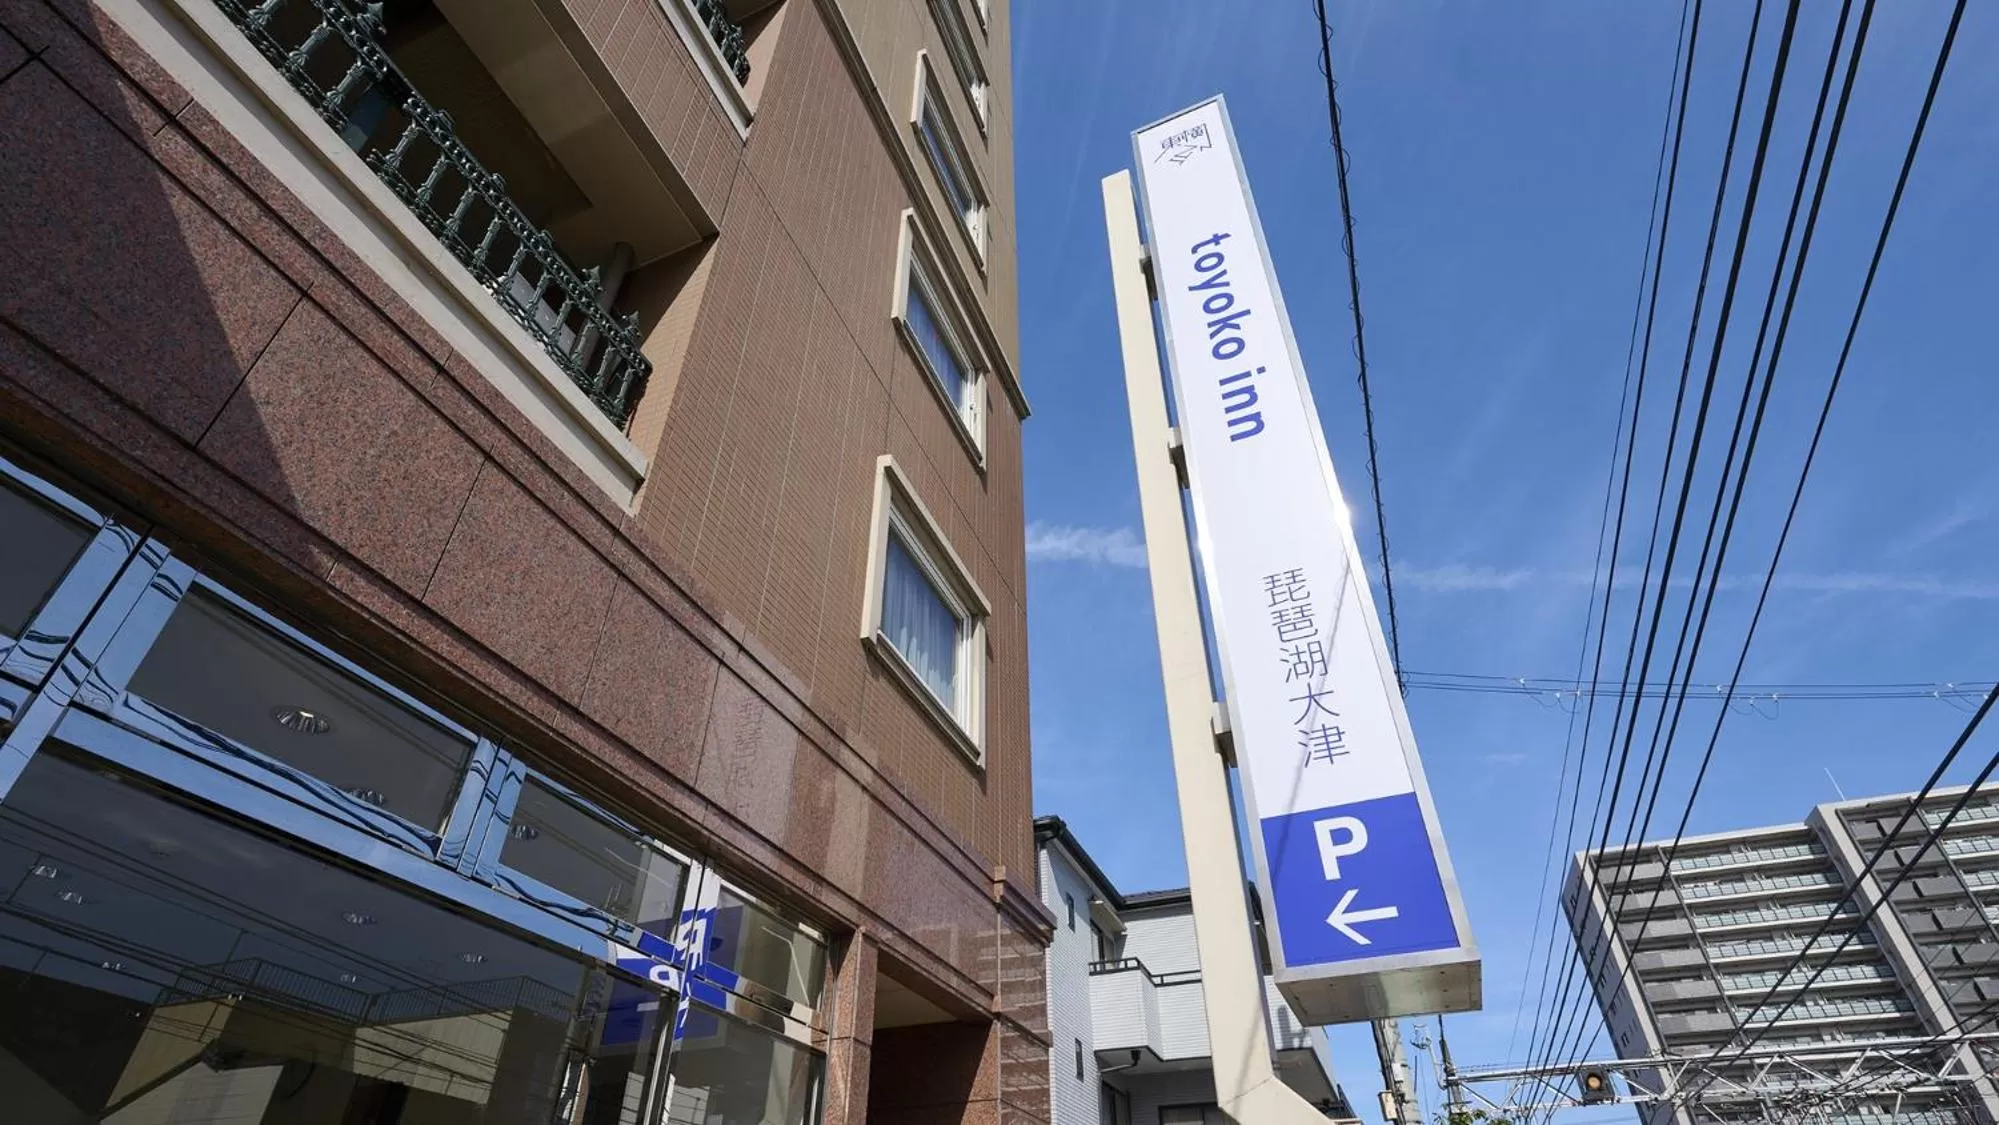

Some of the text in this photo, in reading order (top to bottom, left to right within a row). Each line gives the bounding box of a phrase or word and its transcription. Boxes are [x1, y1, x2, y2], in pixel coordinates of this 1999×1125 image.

[1188, 233, 1266, 442] toyoko inn
[1263, 567, 1350, 769] 琵琶湖大津
[1313, 815, 1368, 880] P
